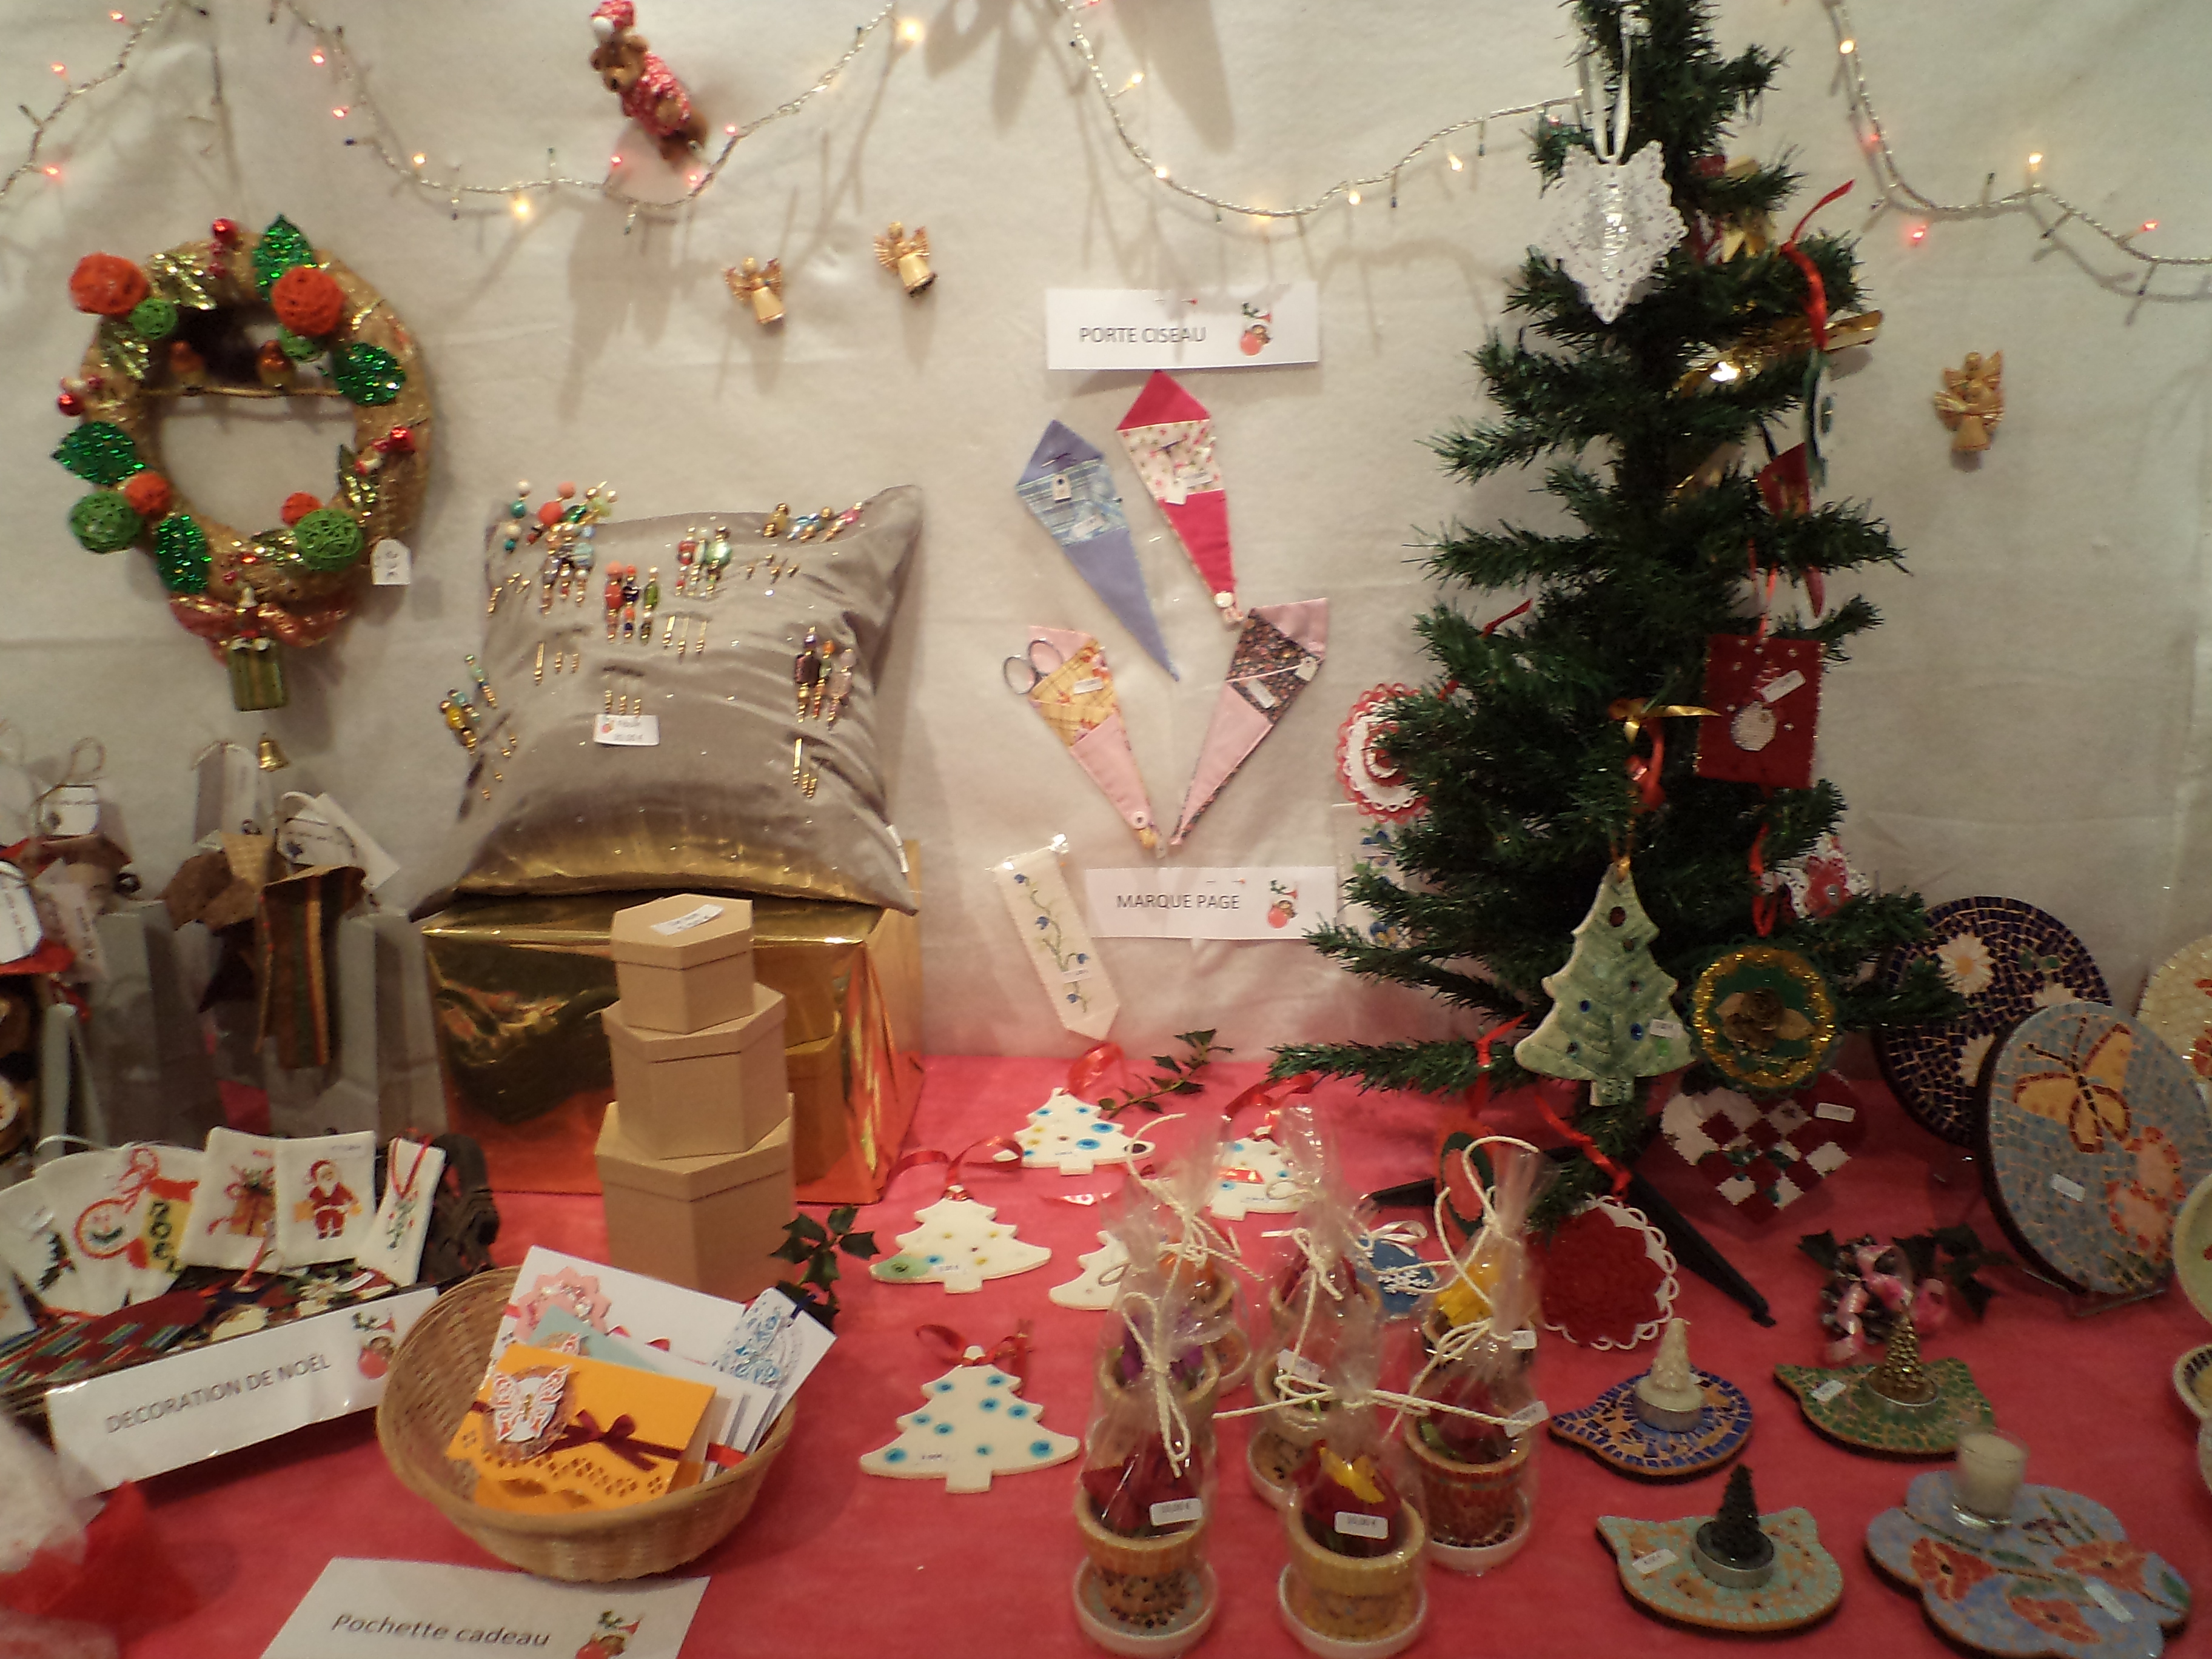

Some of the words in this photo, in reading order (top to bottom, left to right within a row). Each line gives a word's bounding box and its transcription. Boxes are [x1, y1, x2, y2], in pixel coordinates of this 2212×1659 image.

[1079, 327, 1137, 343] PORTE
[1141, 326, 1207, 343] CISEAU
[1117, 894, 1192, 910] MARQUE
[1197, 894, 1240, 910] PAGE
[105, 1379, 242, 1433] DECORATION
[246, 1369, 274, 1391] DE
[332, 1613, 449, 1640] Pochette
[455, 1625, 551, 1647] cadeau
